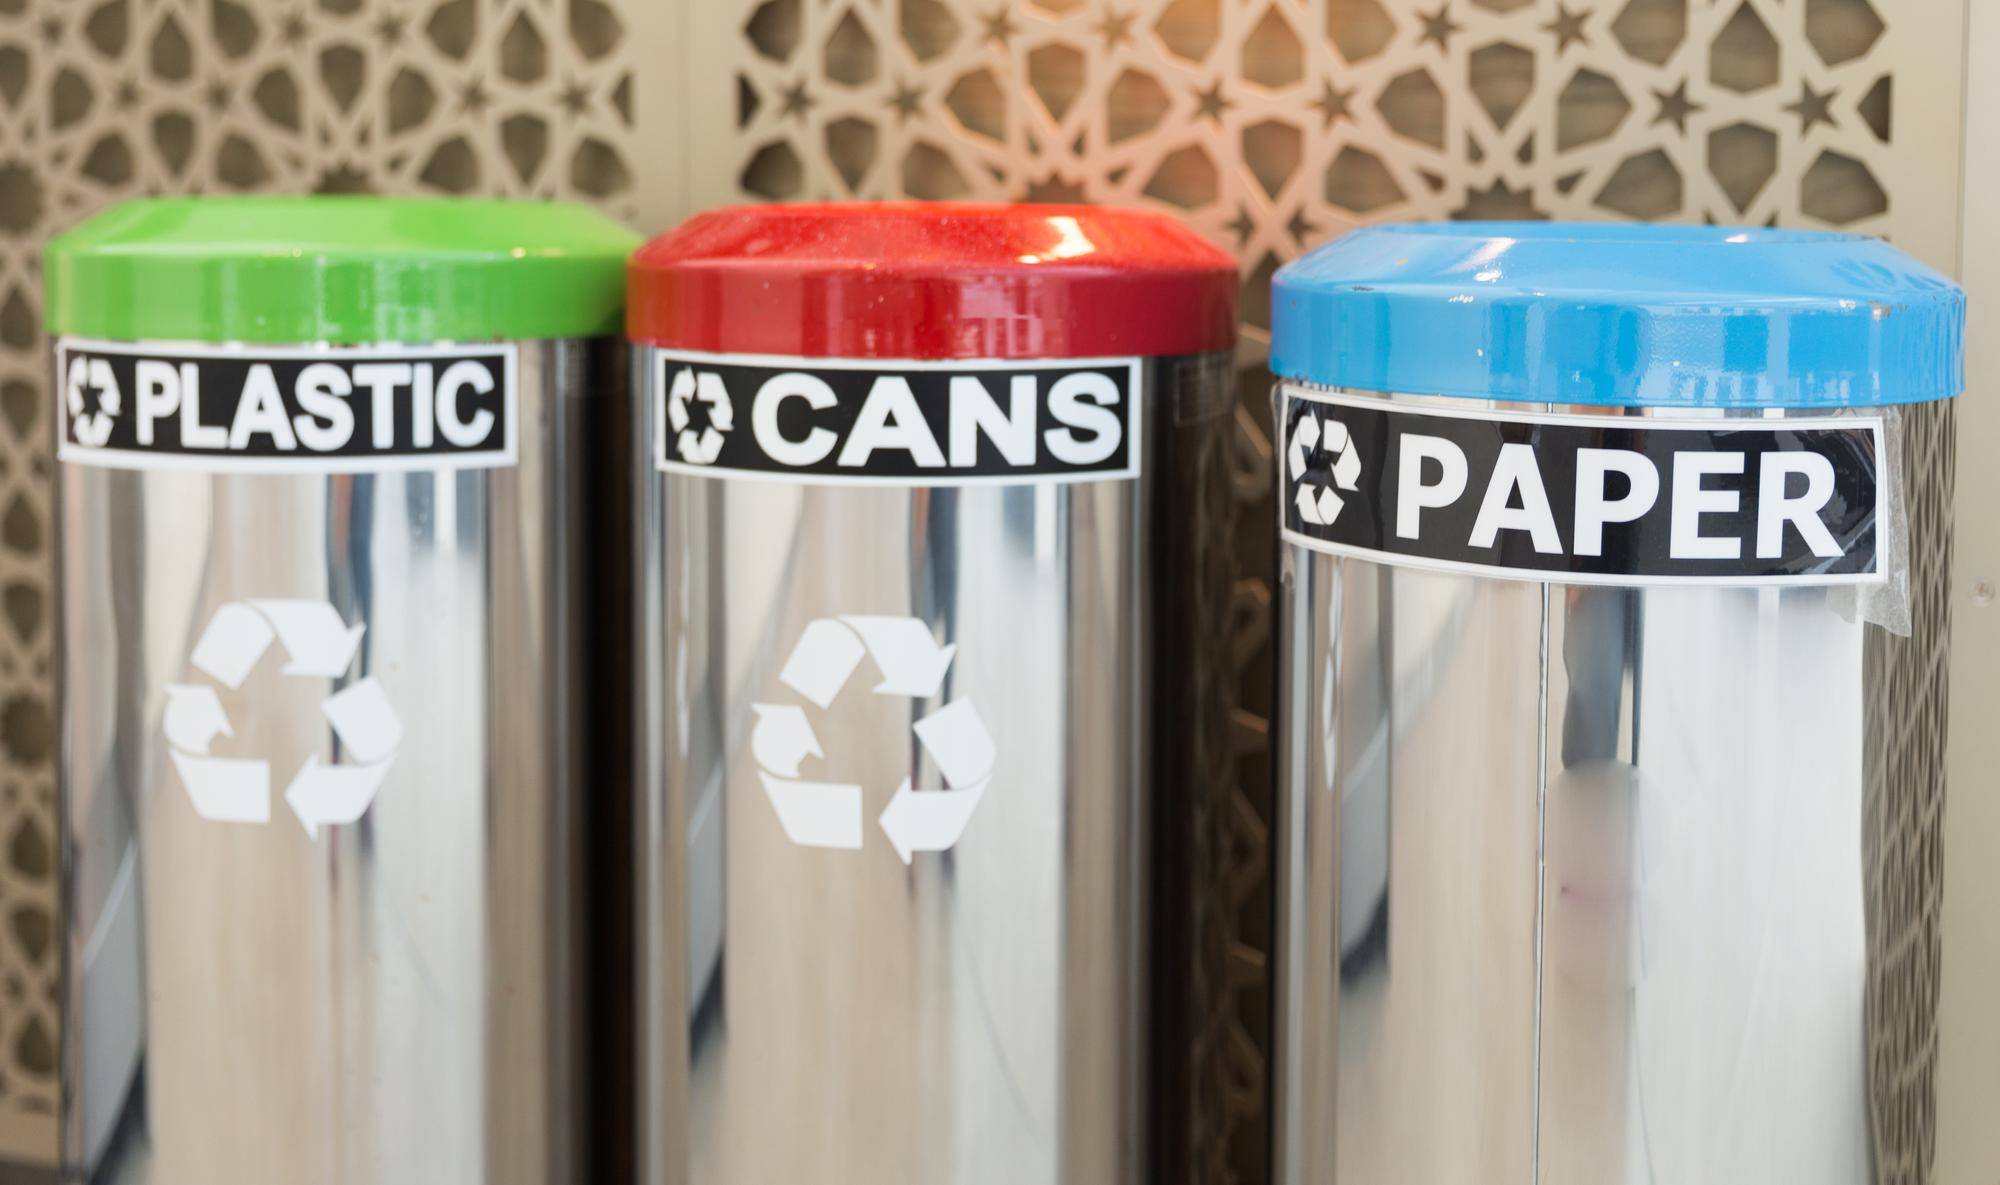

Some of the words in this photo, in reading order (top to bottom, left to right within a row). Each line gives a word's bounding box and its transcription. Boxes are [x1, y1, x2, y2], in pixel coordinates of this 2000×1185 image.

[136, 361, 494, 450] PLASTIC
[753, 373, 1122, 467] CANS
[1396, 432, 1846, 560] PAPER
